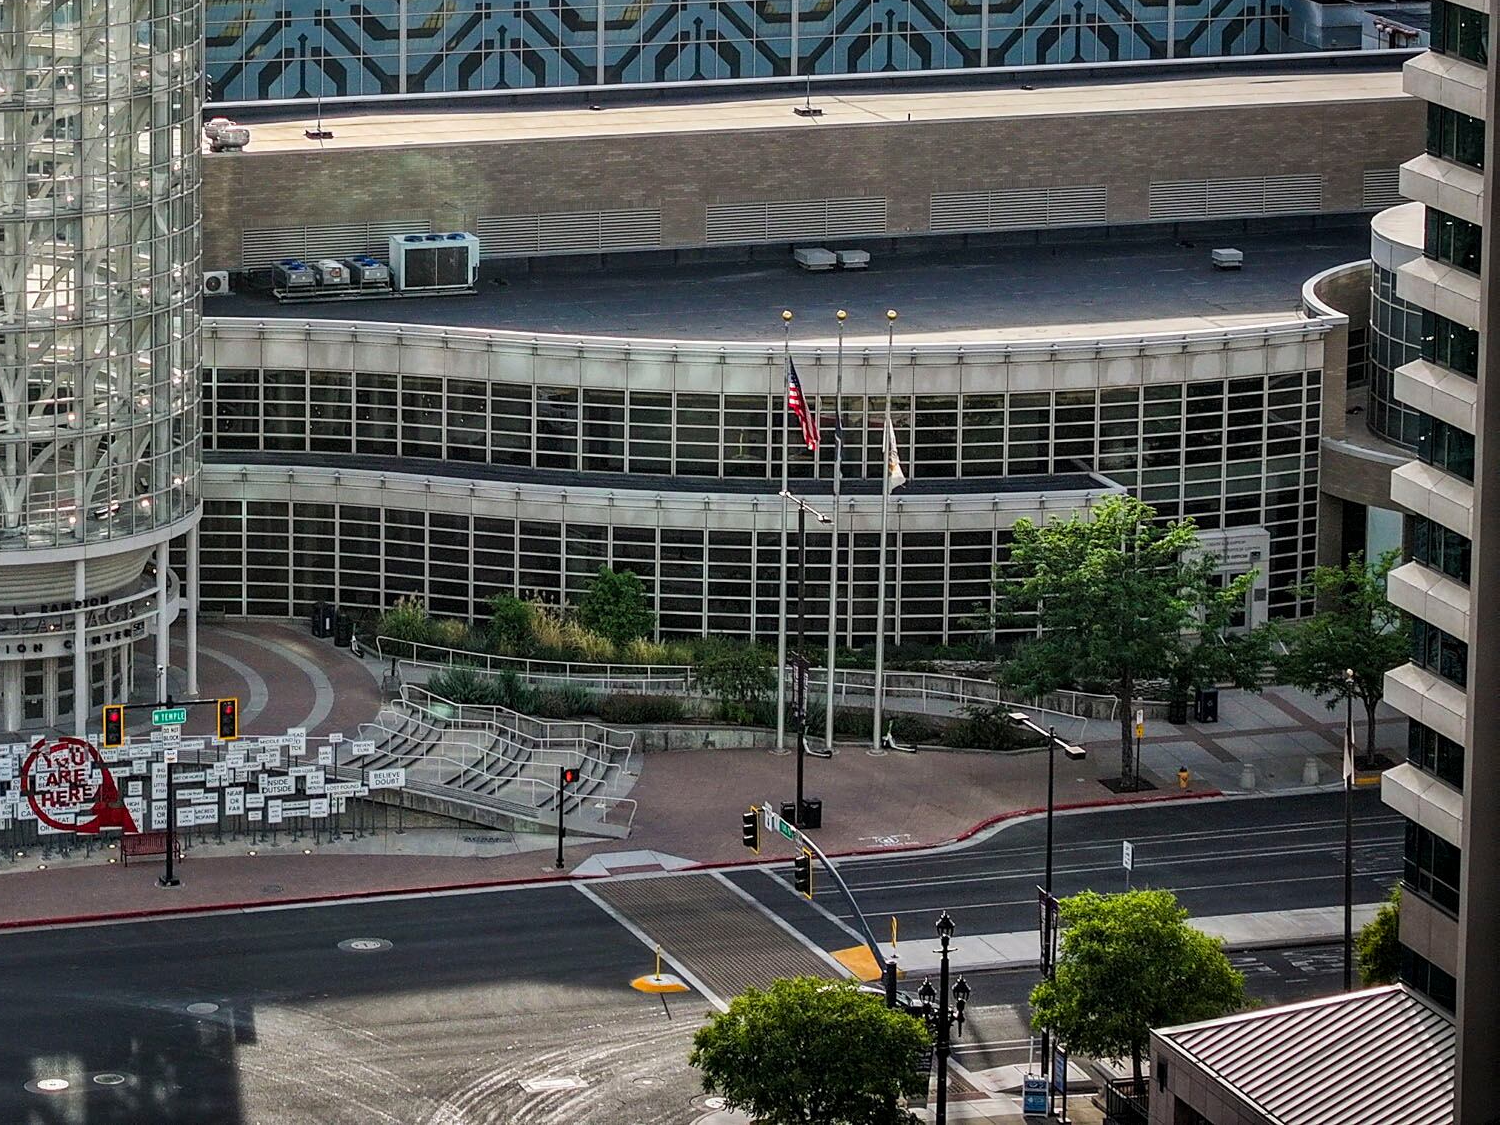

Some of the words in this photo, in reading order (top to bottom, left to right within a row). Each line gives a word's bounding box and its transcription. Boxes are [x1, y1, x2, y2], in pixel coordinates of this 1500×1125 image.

[41, 595, 109, 614] RAMPTON
[161, 712, 185, 720] TEMPLE
[46, 769, 86, 787] ARE
[42, 786, 95, 807] HERE
